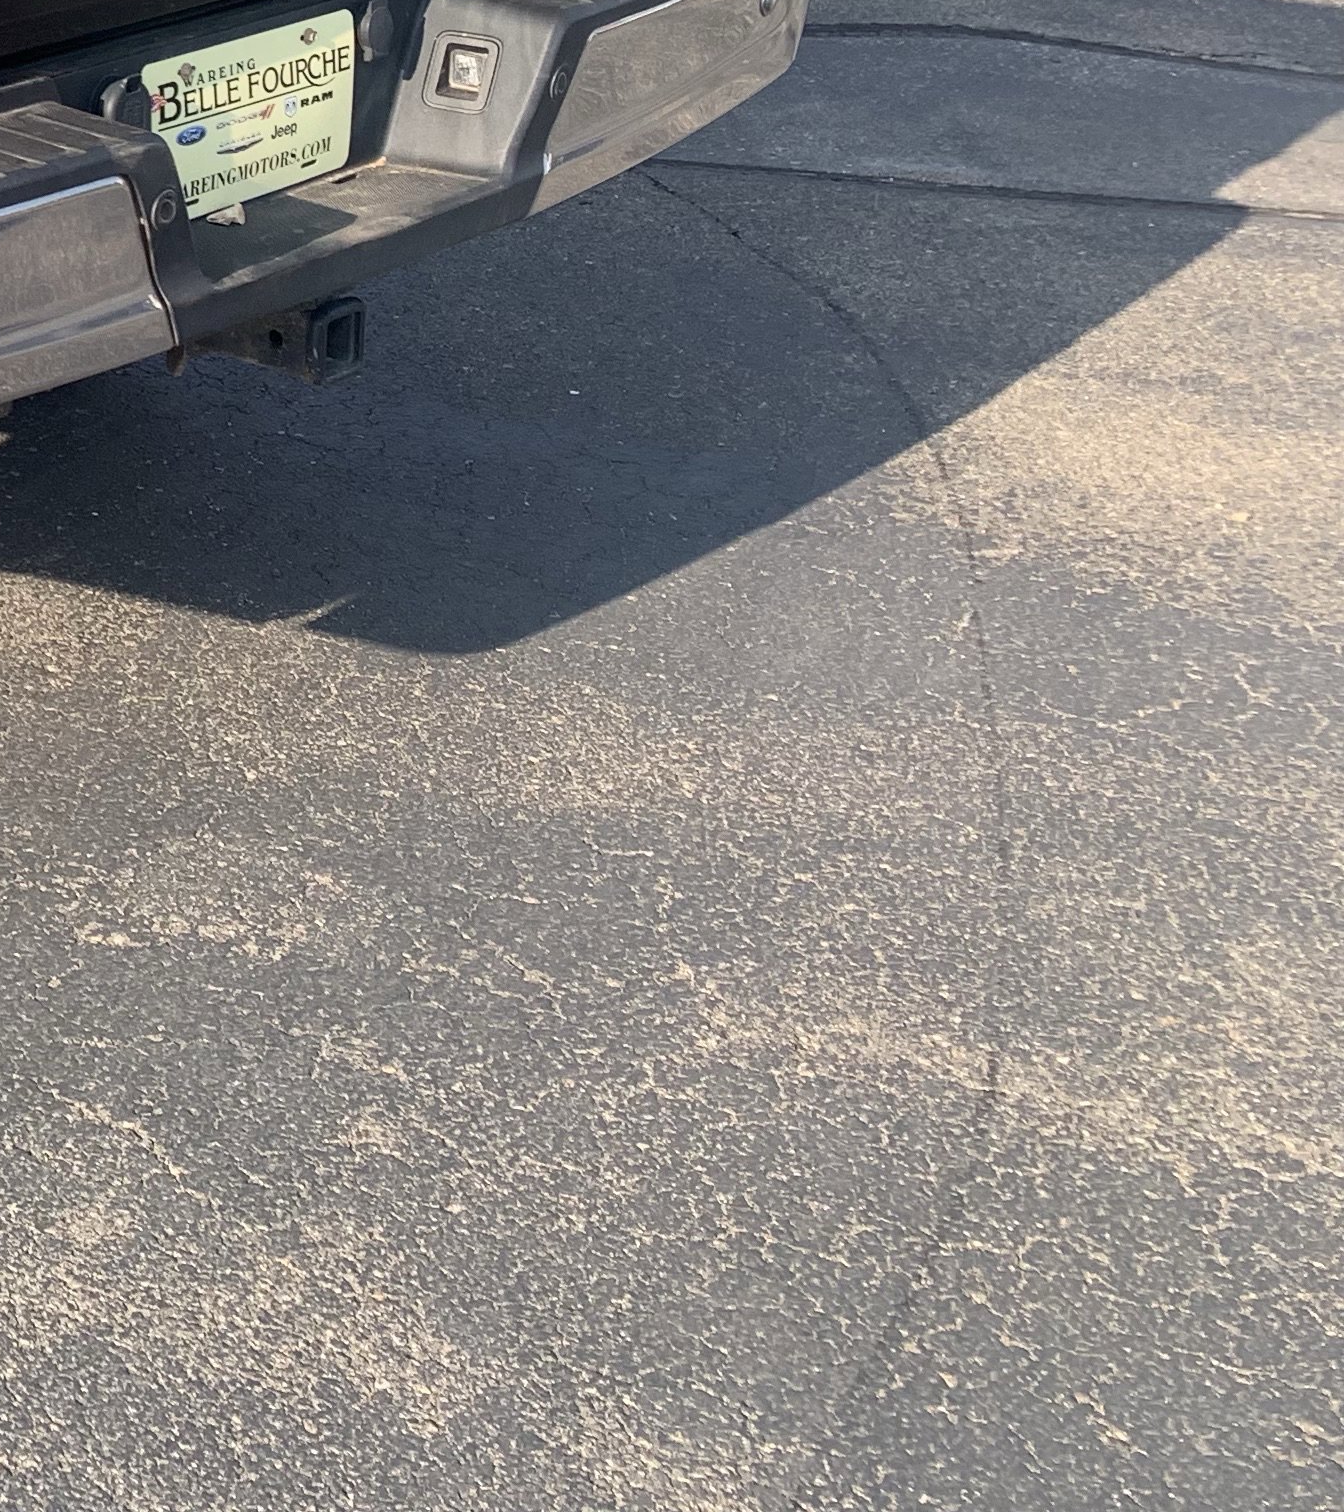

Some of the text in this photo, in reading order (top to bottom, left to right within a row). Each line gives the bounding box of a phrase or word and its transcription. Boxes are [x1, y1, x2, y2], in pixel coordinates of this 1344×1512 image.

[157, 45, 351, 126] BELLE FOURCHE
[181, 57, 257, 88] WAREING
[300, 90, 334, 109] RAM
[270, 122, 298, 140] Jeep
[183, 136, 332, 199] AREINGMOTORS.COM
